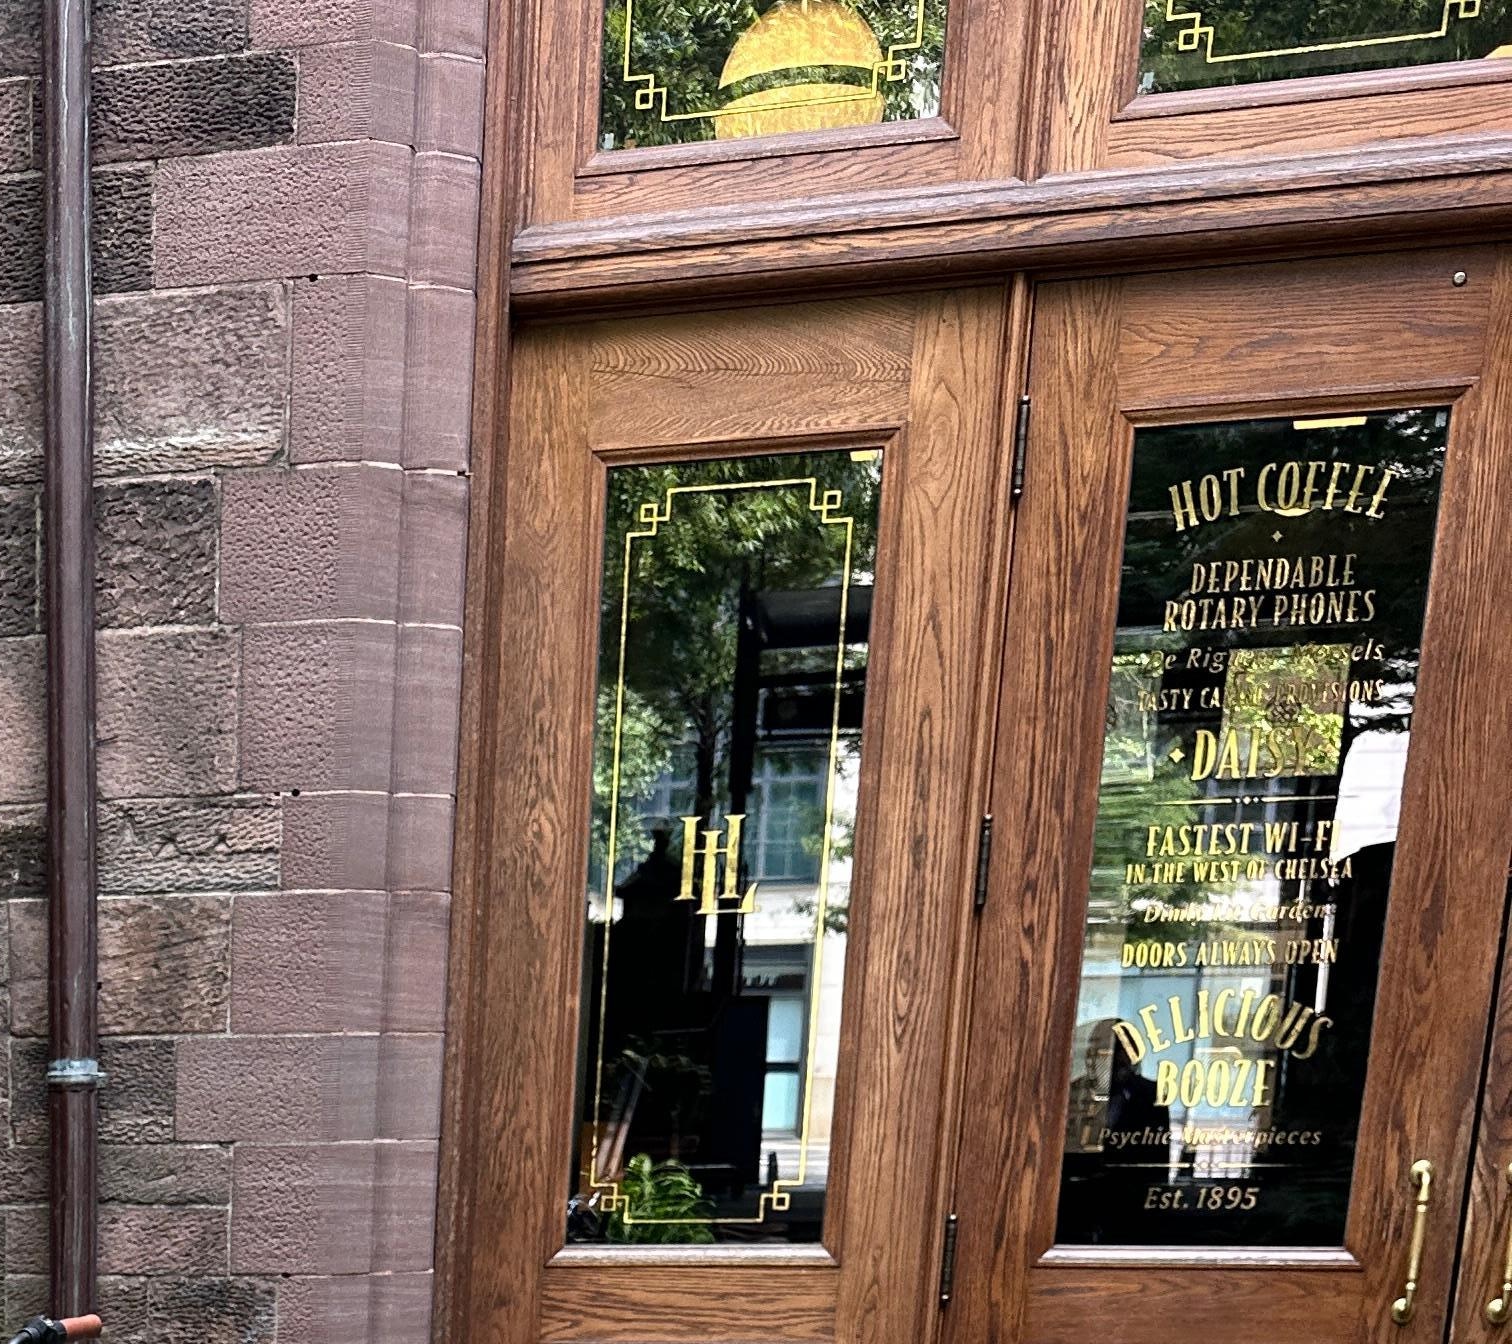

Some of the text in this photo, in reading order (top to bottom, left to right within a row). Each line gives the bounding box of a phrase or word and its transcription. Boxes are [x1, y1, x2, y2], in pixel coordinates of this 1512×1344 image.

[1168, 460, 1399, 531] HOT COFFEE
[1190, 553, 1358, 595] DEPENDABLE
[1163, 589, 1377, 632] ROTARY PHONES
[1138, 687, 1194, 713] TASTY
[1190, 725, 1312, 781] DAISY
[1146, 819, 1344, 857] FASTEST WI-FI
[1125, 857, 1353, 885] IN THE WEST OF CHELSEA
[1121, 938, 1339, 968] DOORS ALWAYS OPEN
[1112, 987, 1335, 1066] DELICIOUS
[1153, 1058, 1276, 1108] BOOZE
[1099, 1125, 1172, 1149] Psychic
[1144, 1186, 1261, 1211] Est. 1895
